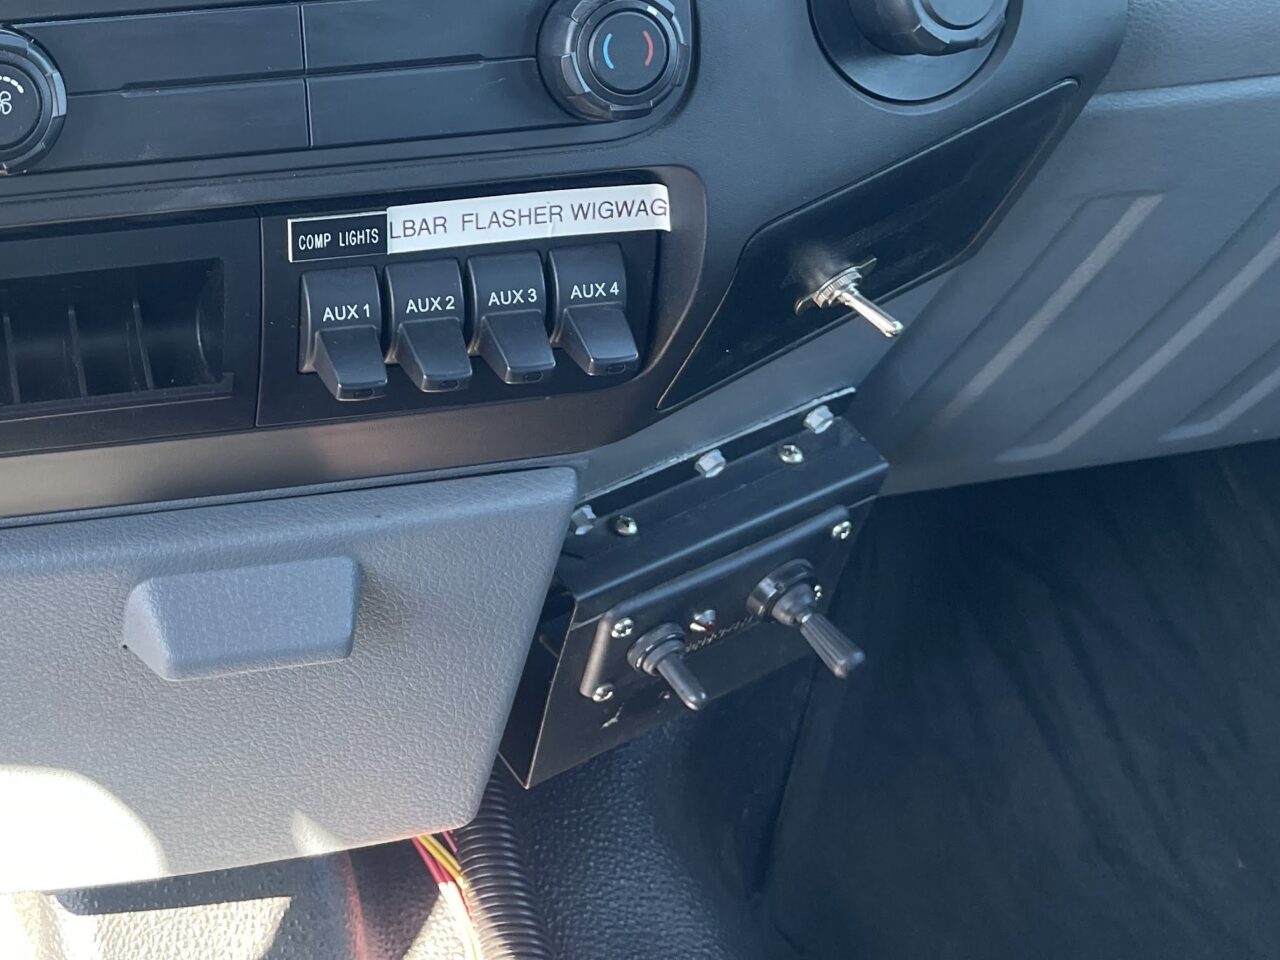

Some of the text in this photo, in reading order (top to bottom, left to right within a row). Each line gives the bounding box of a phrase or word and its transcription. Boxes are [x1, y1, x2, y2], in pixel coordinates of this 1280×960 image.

[389, 198, 668, 239] LBAR FLASHER WIGWAG
[298, 228, 379, 251] COMP LIGHTS
[488, 288, 537, 307] AUX 3
[570, 282, 620, 300] AUX 4
[322, 303, 370, 322] AUX 1
[405, 296, 455, 314] AUX 2
